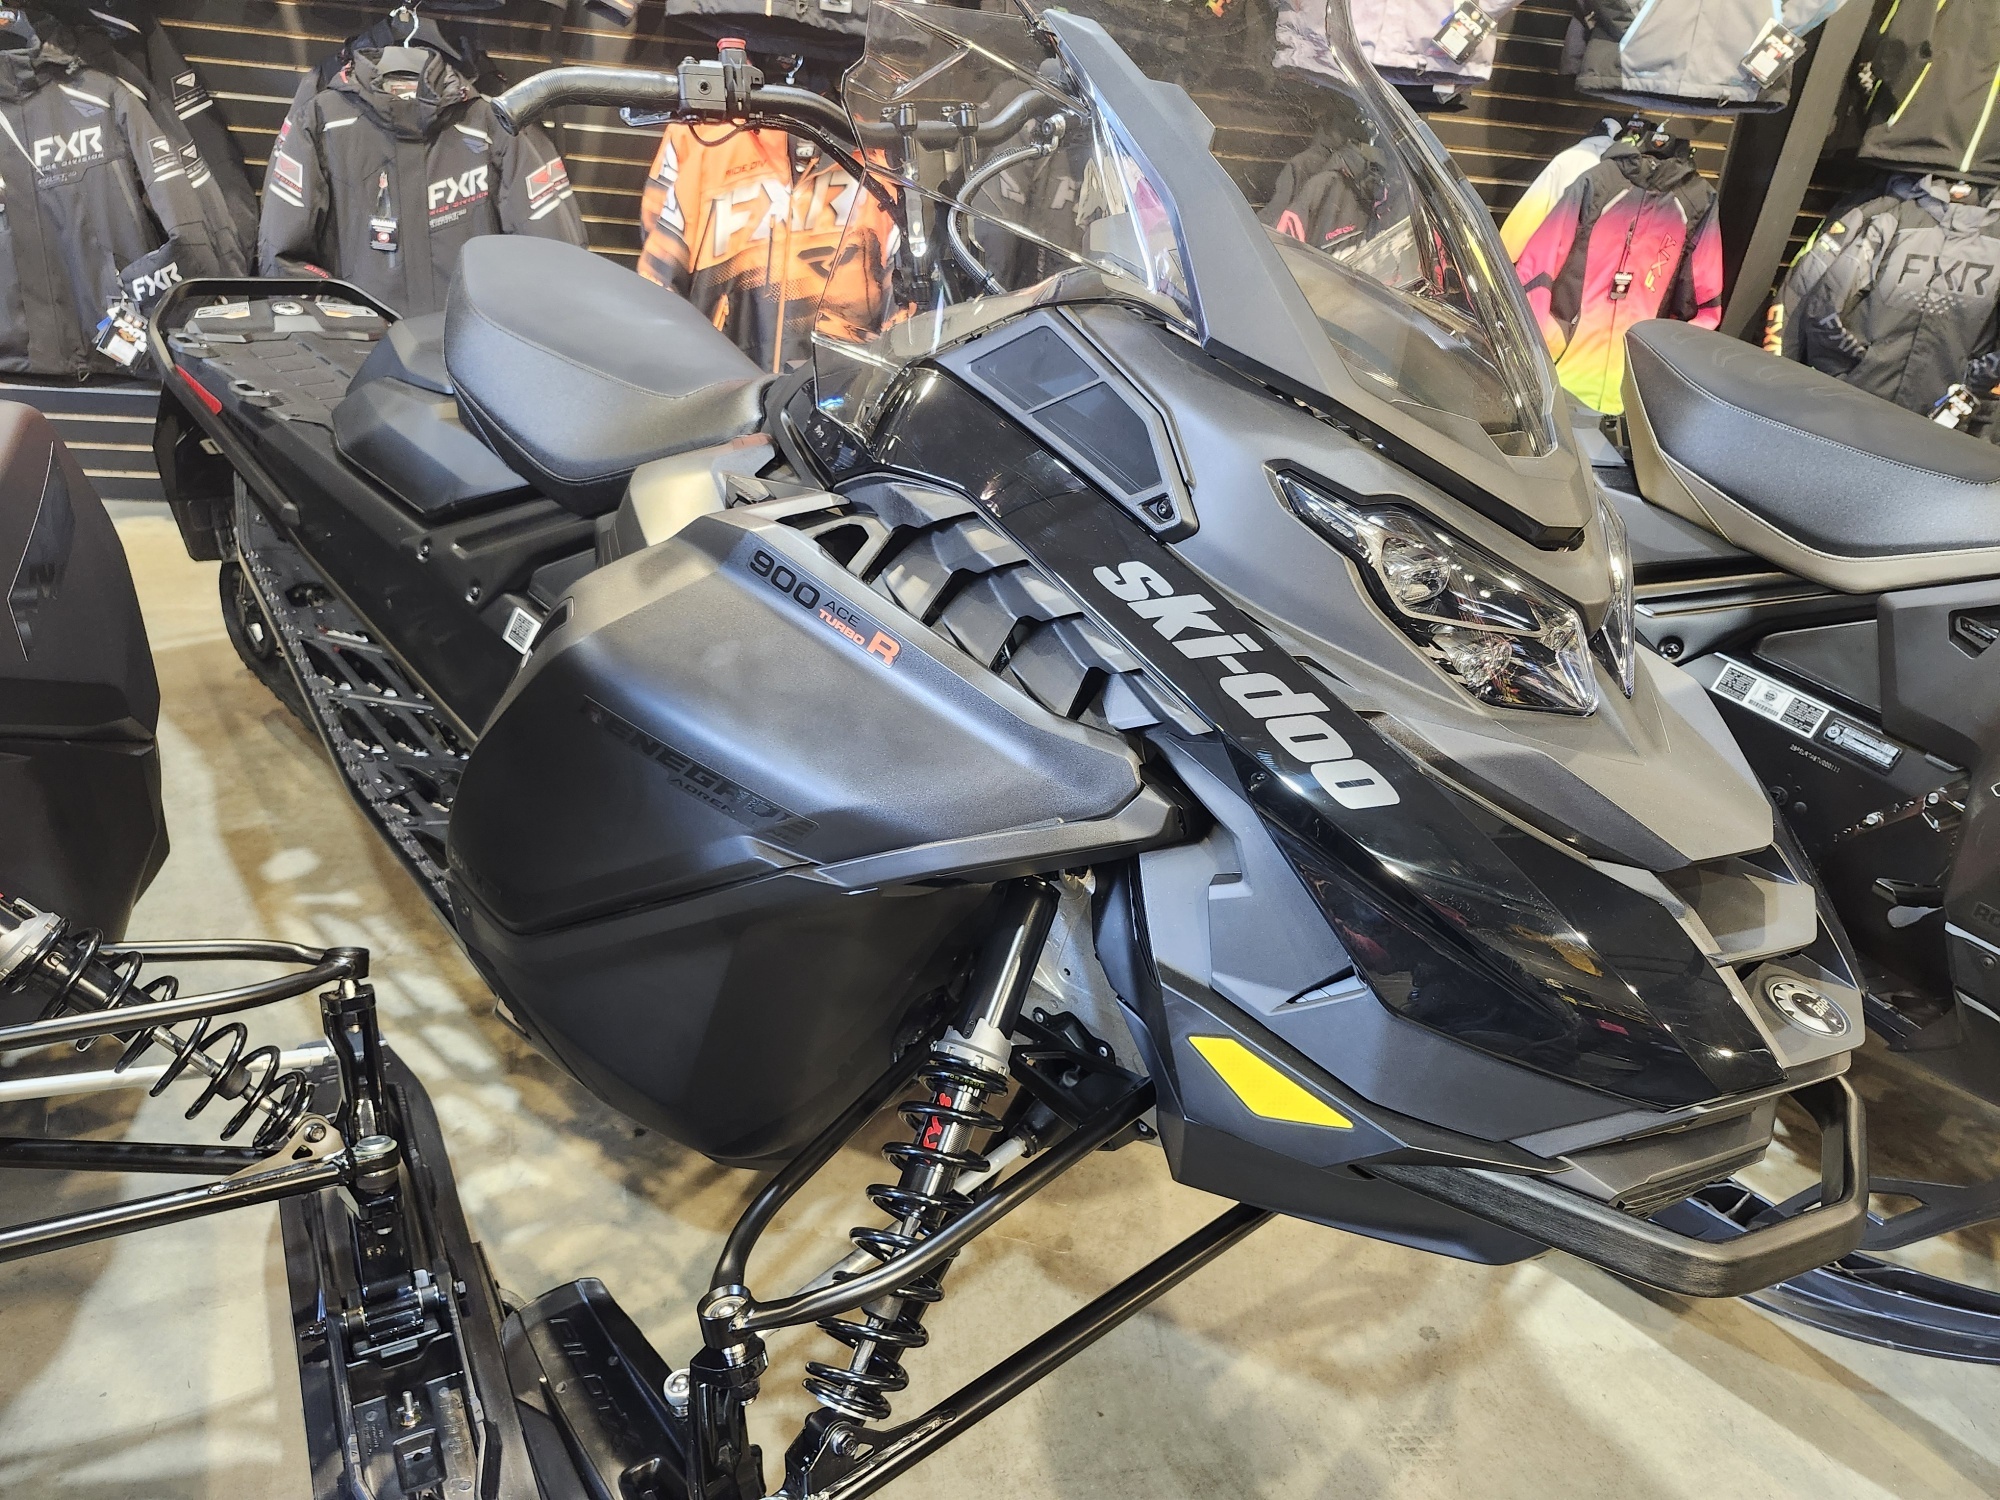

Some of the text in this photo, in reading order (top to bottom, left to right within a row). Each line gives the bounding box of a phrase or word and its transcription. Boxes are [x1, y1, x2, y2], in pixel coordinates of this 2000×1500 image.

[34, 125, 103, 167] FXR
[428, 165, 489, 210] FXR
[712, 169, 867, 257] FXR
[132, 262, 182, 301] FXR
[1644, 232, 1676, 292] FXR
[1897, 253, 1994, 296] FXR
[750, 550, 860, 627] 900 ACE
[819, 608, 900, 666] TURBO R
[1812, 998, 1830, 1017] BRP
